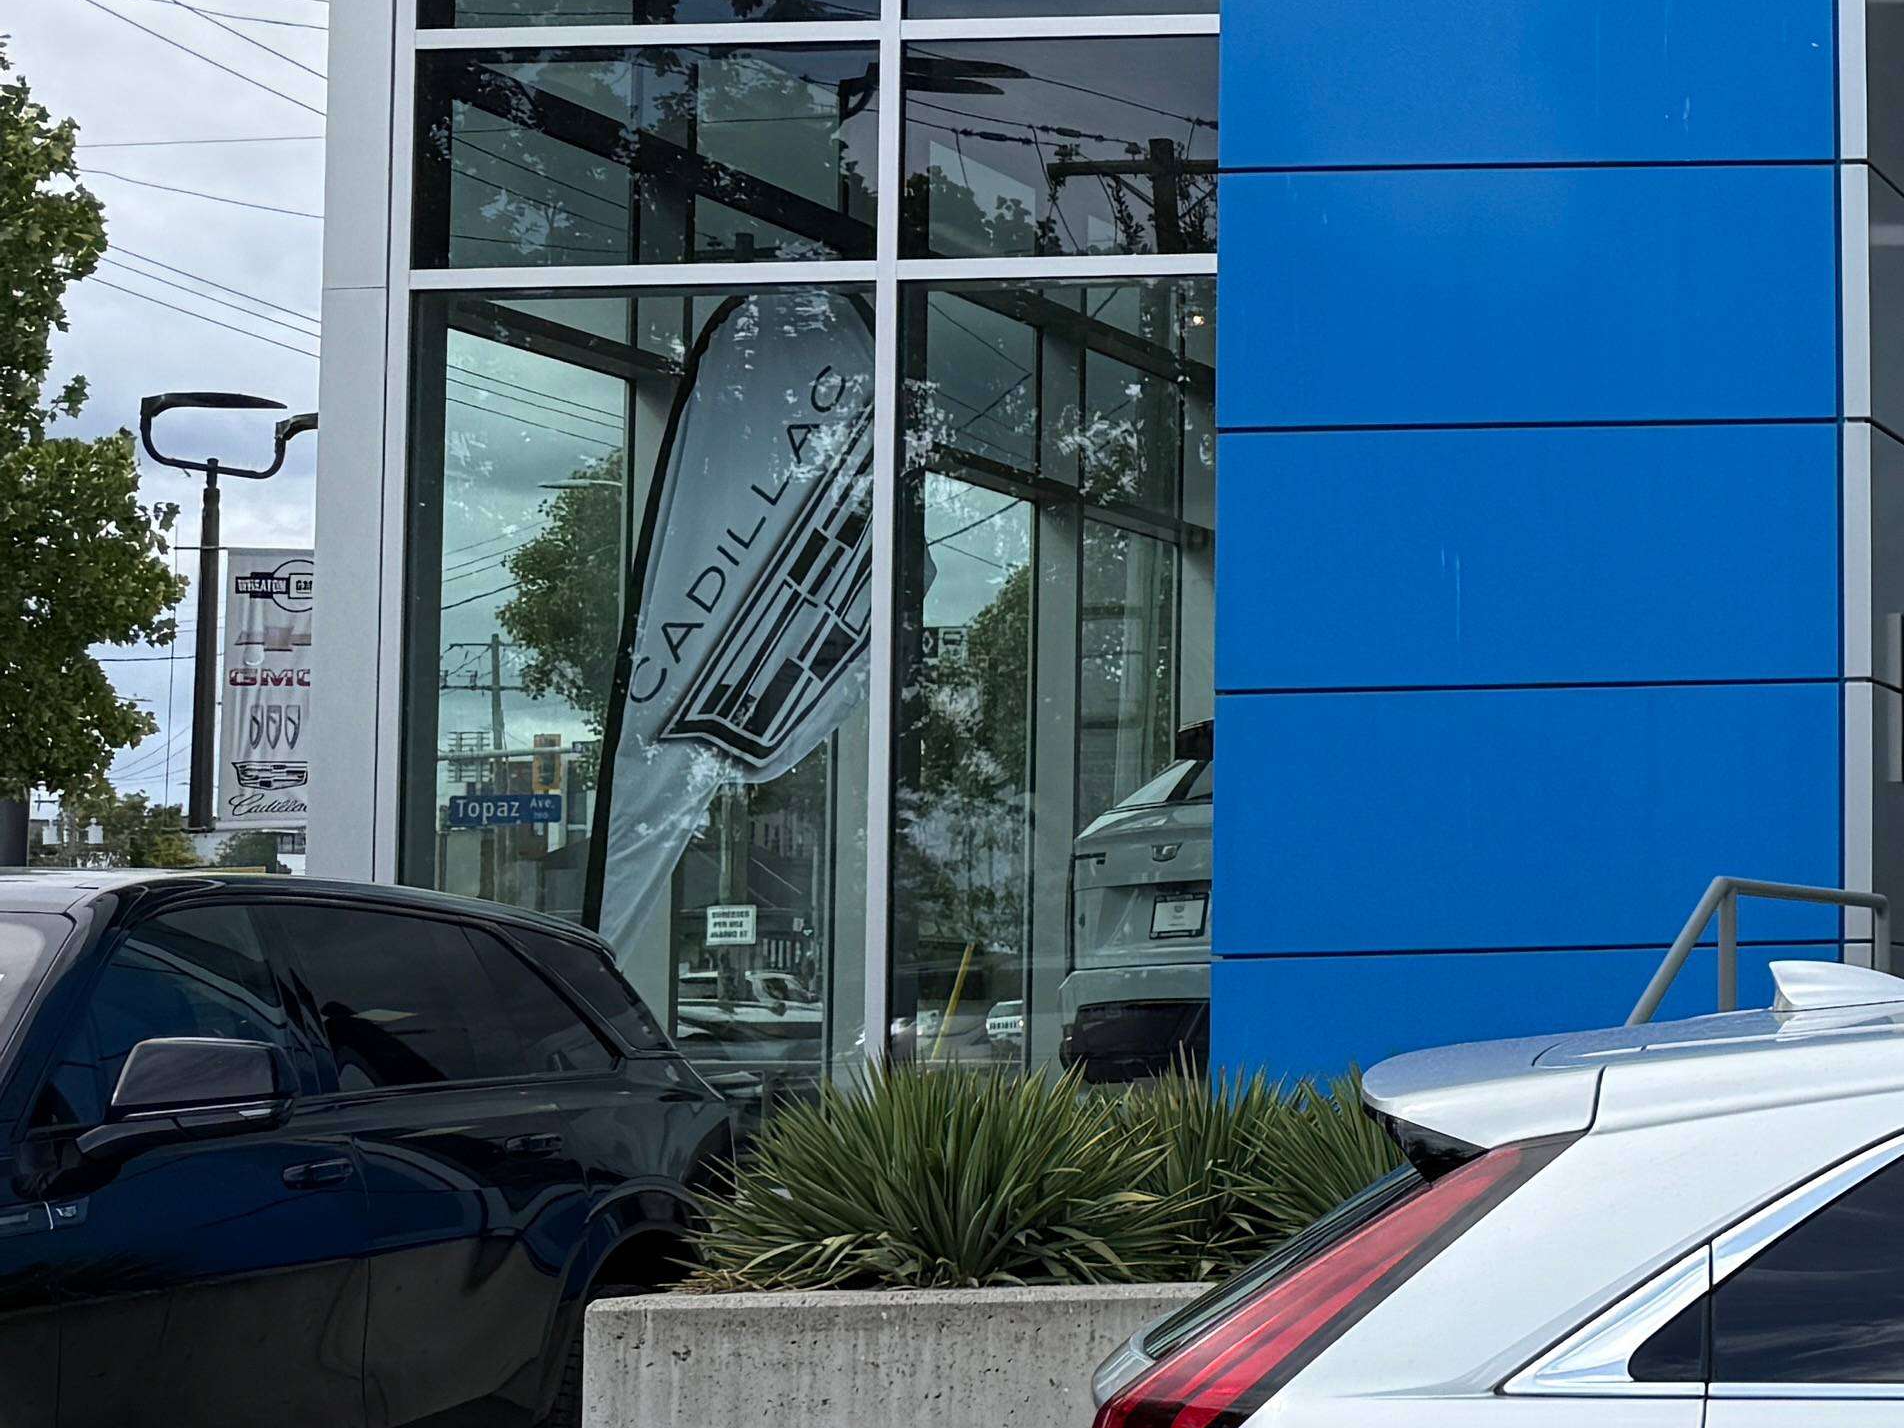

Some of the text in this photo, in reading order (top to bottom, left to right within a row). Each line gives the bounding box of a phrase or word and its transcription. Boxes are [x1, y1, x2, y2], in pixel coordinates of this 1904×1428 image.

[629, 365, 846, 704] CADILLAC
[229, 792, 308, 817] Cadilla
[455, 797, 556, 824] Topaz Ave.
